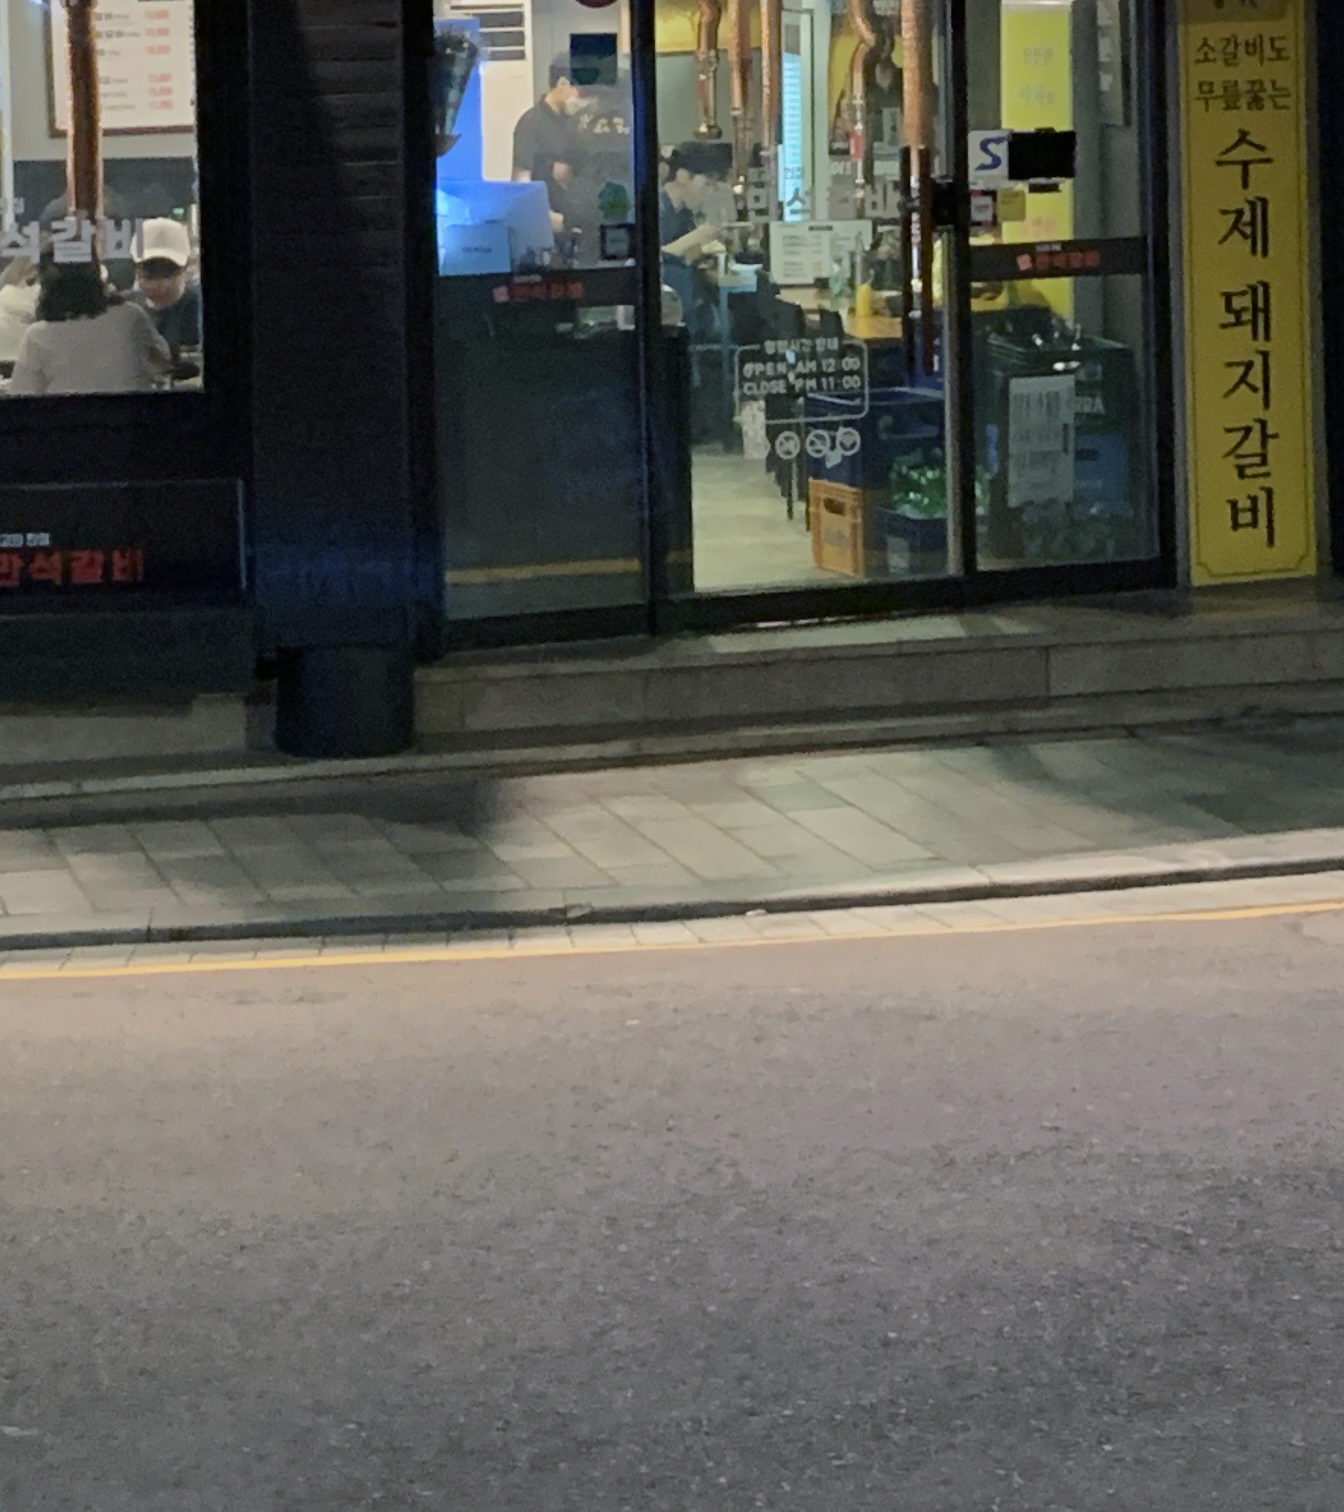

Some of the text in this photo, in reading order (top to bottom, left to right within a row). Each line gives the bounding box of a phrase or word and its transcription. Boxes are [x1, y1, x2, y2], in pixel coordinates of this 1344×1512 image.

[1194, 33, 1291, 67] 소갈비도
[1214, 128, 1274, 258] 수제
[743, 361, 788, 378] OPEN
[795, 360, 817, 374] AM
[794, 377, 818, 391] PM
